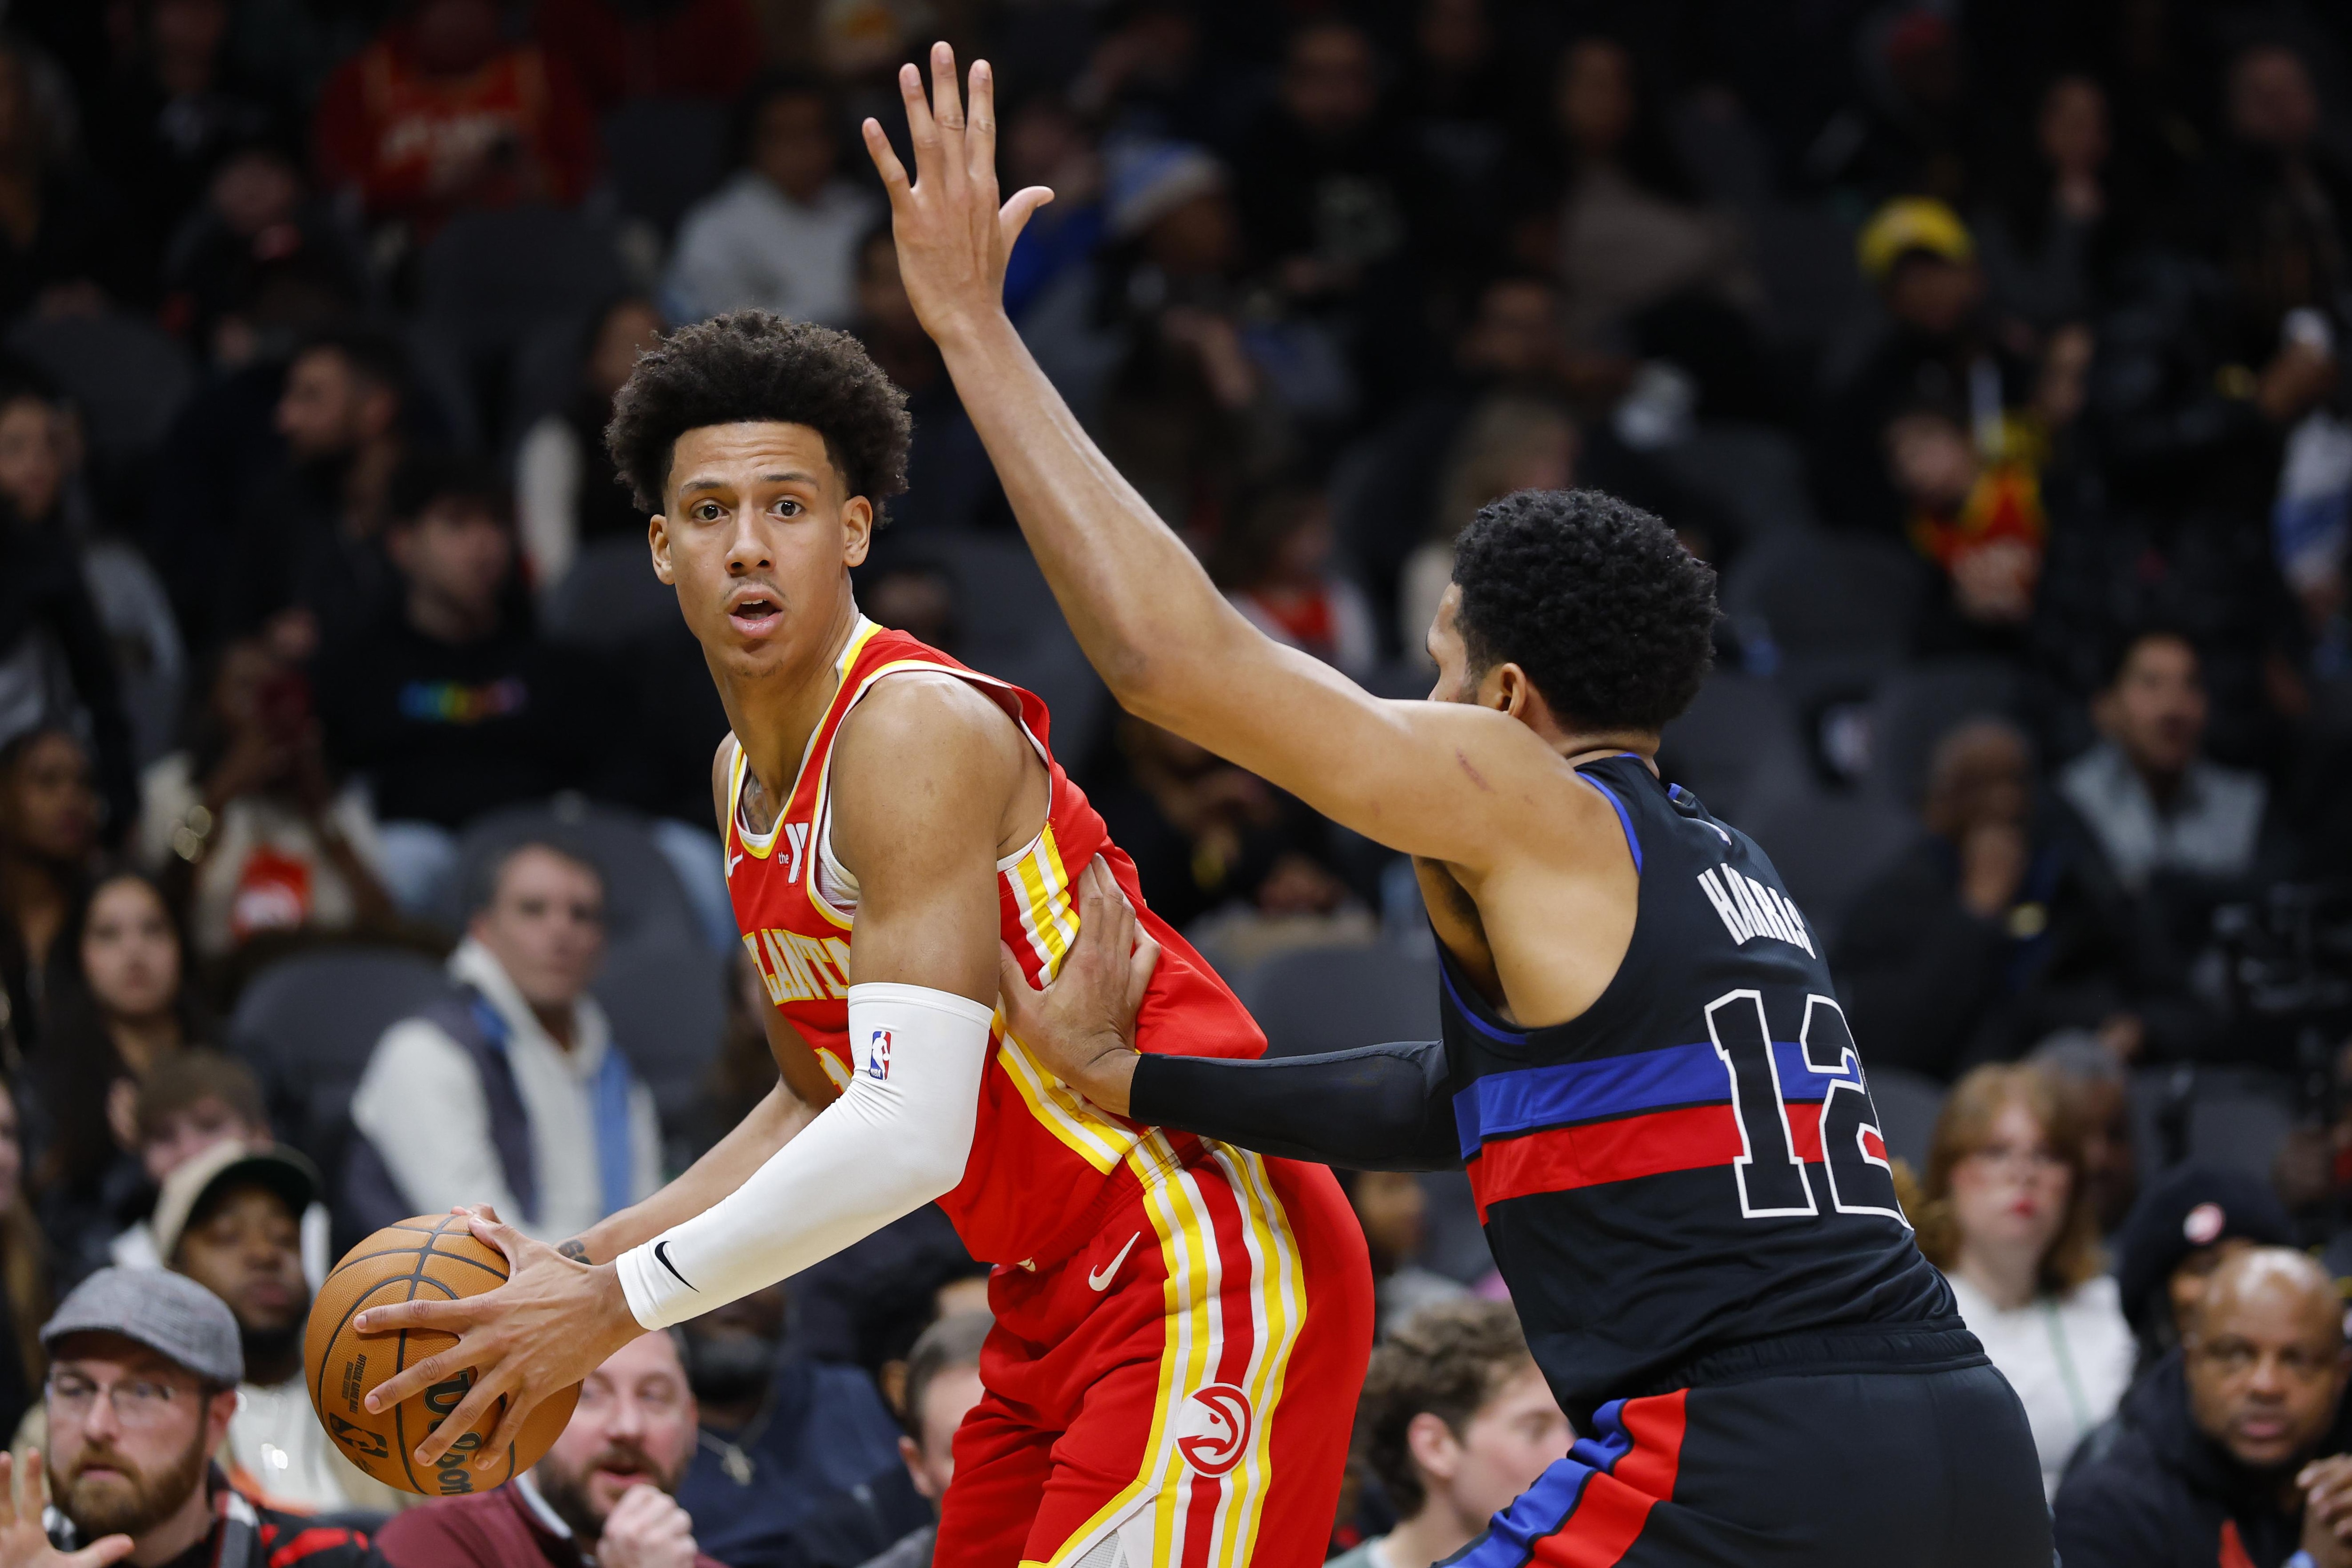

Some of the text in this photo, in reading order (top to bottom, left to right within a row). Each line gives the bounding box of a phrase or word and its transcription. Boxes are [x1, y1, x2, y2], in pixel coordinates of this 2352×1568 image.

[779, 851, 789, 864] the
[785, 823, 809, 883] Y
[1696, 862, 1816, 959] HARRIS
[870, 1068, 881, 1078] NBA
[1705, 989, 1914, 1231] 12
